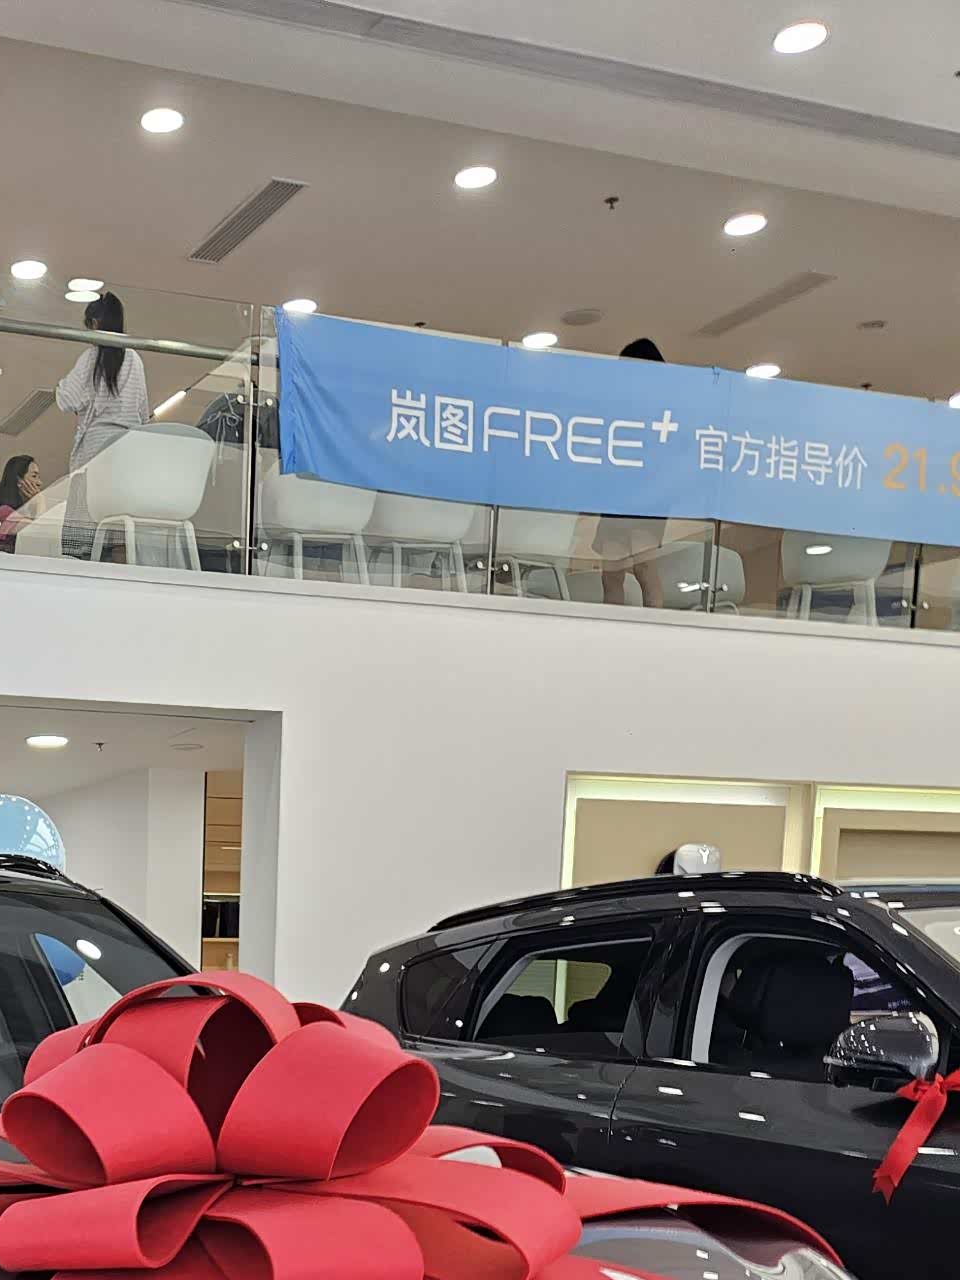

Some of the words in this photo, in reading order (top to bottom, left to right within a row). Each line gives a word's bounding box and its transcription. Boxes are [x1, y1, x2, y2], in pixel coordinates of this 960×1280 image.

[695, 424, 869, 490] 官方指导价
